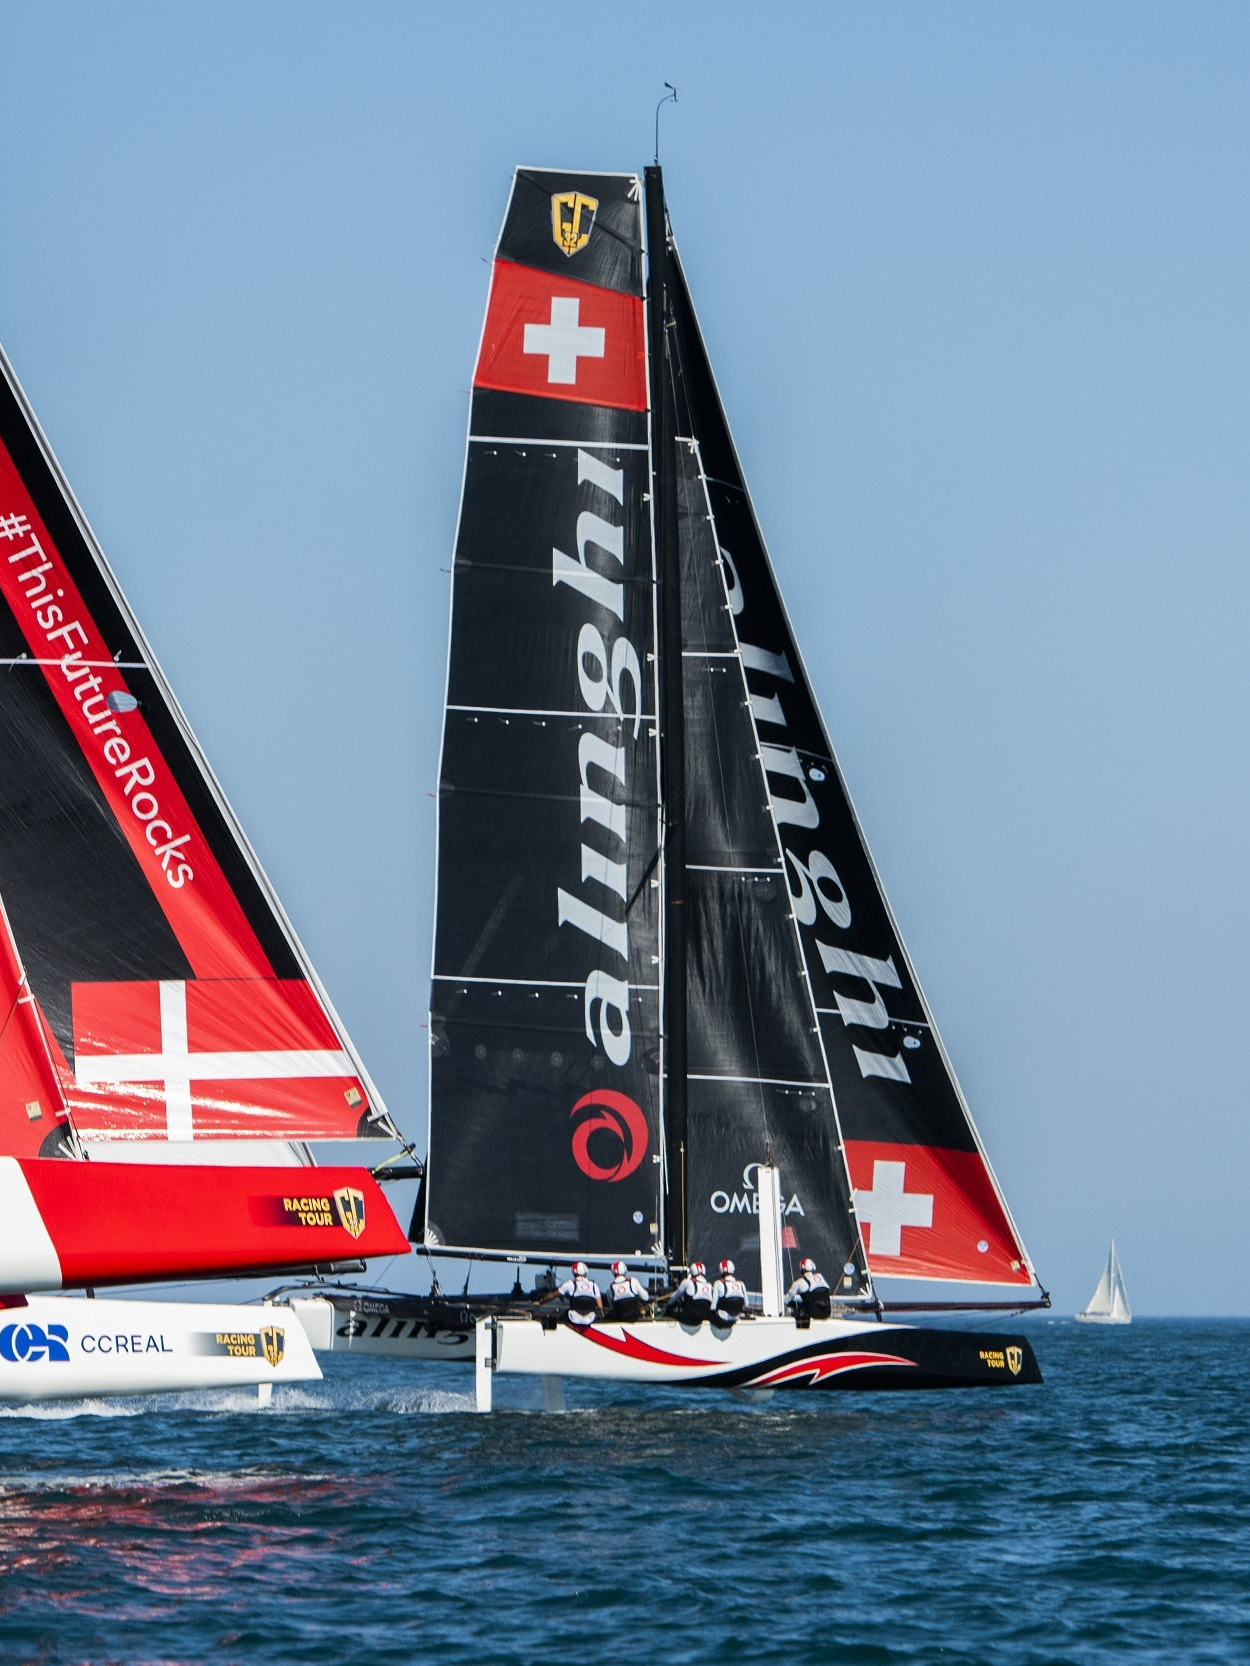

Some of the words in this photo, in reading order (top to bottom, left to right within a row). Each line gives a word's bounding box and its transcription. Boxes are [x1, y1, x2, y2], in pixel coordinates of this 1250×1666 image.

[552, 447, 642, 1067] alinghi
[282, 1197, 331, 1213] RACING
[710, 1190, 806, 1217] OMEA
[297, 1211, 334, 1227] TOUR
[80, 1334, 174, 1354] CCREAL
[215, 1333, 256, 1346] RACING
[227, 1344, 257, 1358] TOUR
[979, 1350, 1005, 1360] RACING
[986, 1359, 1006, 1368] TOUR
